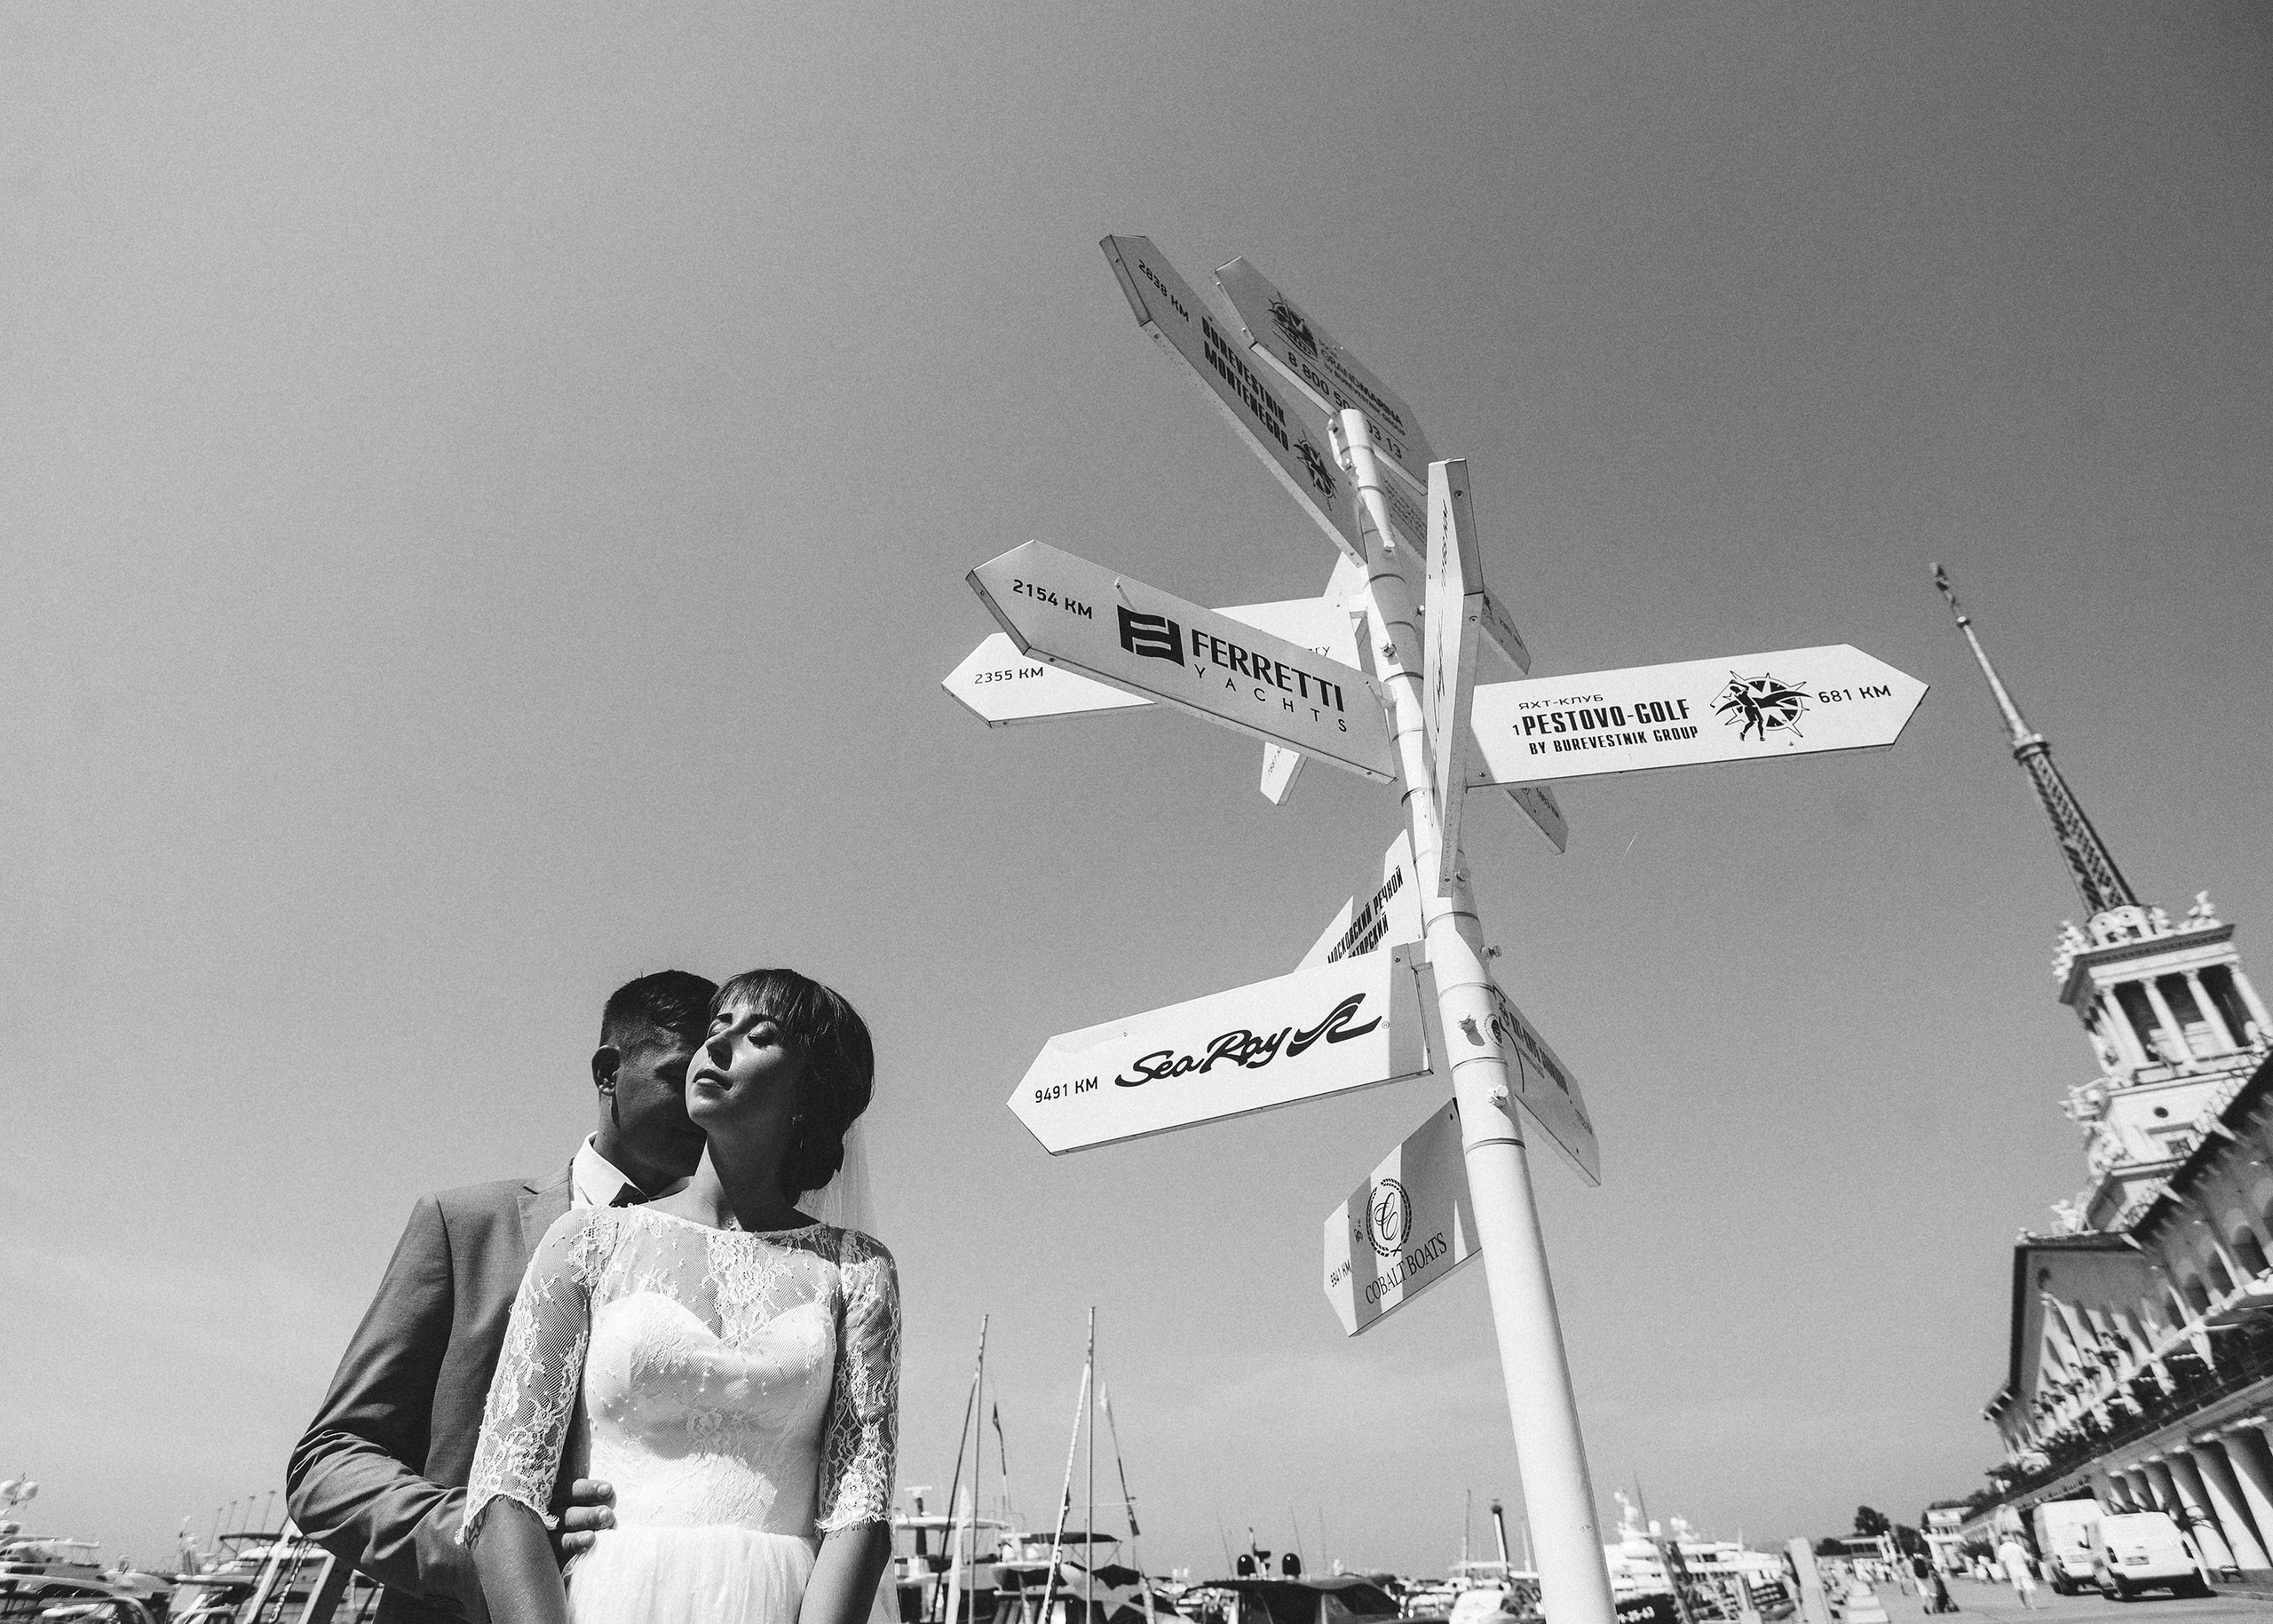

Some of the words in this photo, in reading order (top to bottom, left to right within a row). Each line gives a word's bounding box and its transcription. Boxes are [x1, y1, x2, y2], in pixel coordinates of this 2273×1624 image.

[1138, 258, 1168, 297] 2838
[1201, 316, 1287, 427] BUREVESTNIK
[1203, 340, 1289, 452] MONTENEGRO
[1287, 351, 1298, 367] 8
[1302, 364, 1329, 395] 800
[1386, 438, 1402, 458] 13
[1012, 578, 1058, 606] 2154
[974, 669, 1014, 685] 2355
[1191, 629, 1345, 712] FERRETTI
[1193, 664, 1347, 733] YACHTS
[1518, 693, 1604, 710] ЯХТ-КЛУБ
[1818, 687, 1852, 704] 681
[1521, 698, 1690, 736] PESTOVO-GOLF
[1529, 741, 1546, 755] BY
[1553, 731, 1648, 753] BUREVESTNIK
[1653, 725, 1699, 742] GROUP
[1373, 864, 1404, 915] РЕЧНОЙ
[1034, 1083, 1069, 1104] 9491
[1366, 1260, 1406, 1303] COBALT
[1405, 1232, 1447, 1275] BOATS
